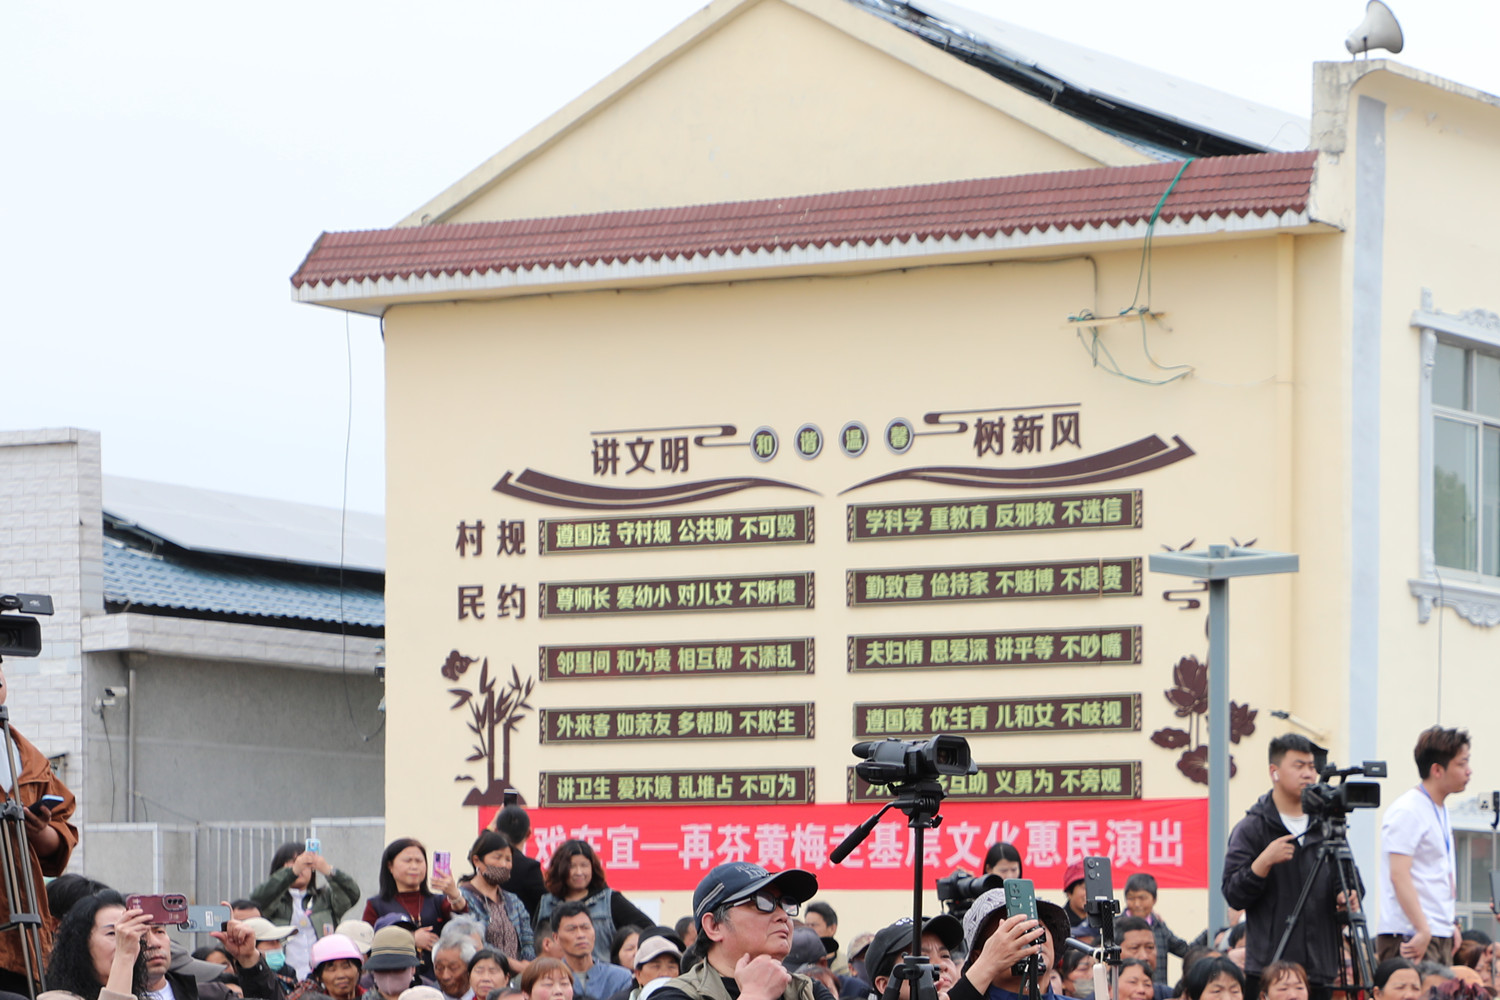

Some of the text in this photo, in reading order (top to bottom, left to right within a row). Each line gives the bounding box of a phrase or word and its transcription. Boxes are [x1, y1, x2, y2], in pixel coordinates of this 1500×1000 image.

[591, 437, 690, 476] 讲文明
[973, 412, 1082, 457] 树新风
[865, 496, 1121, 534] 学科学 重教育 反邪教 不迷信
[455, 519, 526, 558] 村规
[556, 522, 610, 547] 遵国法
[616, 517, 671, 544] 守村规
[677, 516, 733, 541] 公共财
[556, 586, 609, 611] 尊师长
[616, 584, 670, 608] 爱幼小
[677, 582, 732, 606] 对儿女
[864, 574, 923, 599] 勤致富
[995, 568, 1053, 593] 不赌博
[1060, 565, 1122, 590] 不浪费
[457, 583, 526, 621] 民约
[557, 644, 795, 673] 邻里间 和为贵 相互帮 不添乱
[865, 633, 1121, 664] 夫妇情 恩爱深 讲平等 不吵嘴
[557, 709, 794, 736] 外来客 如亲友 多帮助 不欺生
[865, 707, 922, 732] 遵国策
[929, 705, 987, 731] 优生育
[994, 704, 1053, 728] 儿和女
[556, 774, 795, 800] 讲卫生 爱环境 乱堆占 不可为
[995, 769, 1053, 793] 义勇为
[1060, 767, 1121, 792] 不旁观
